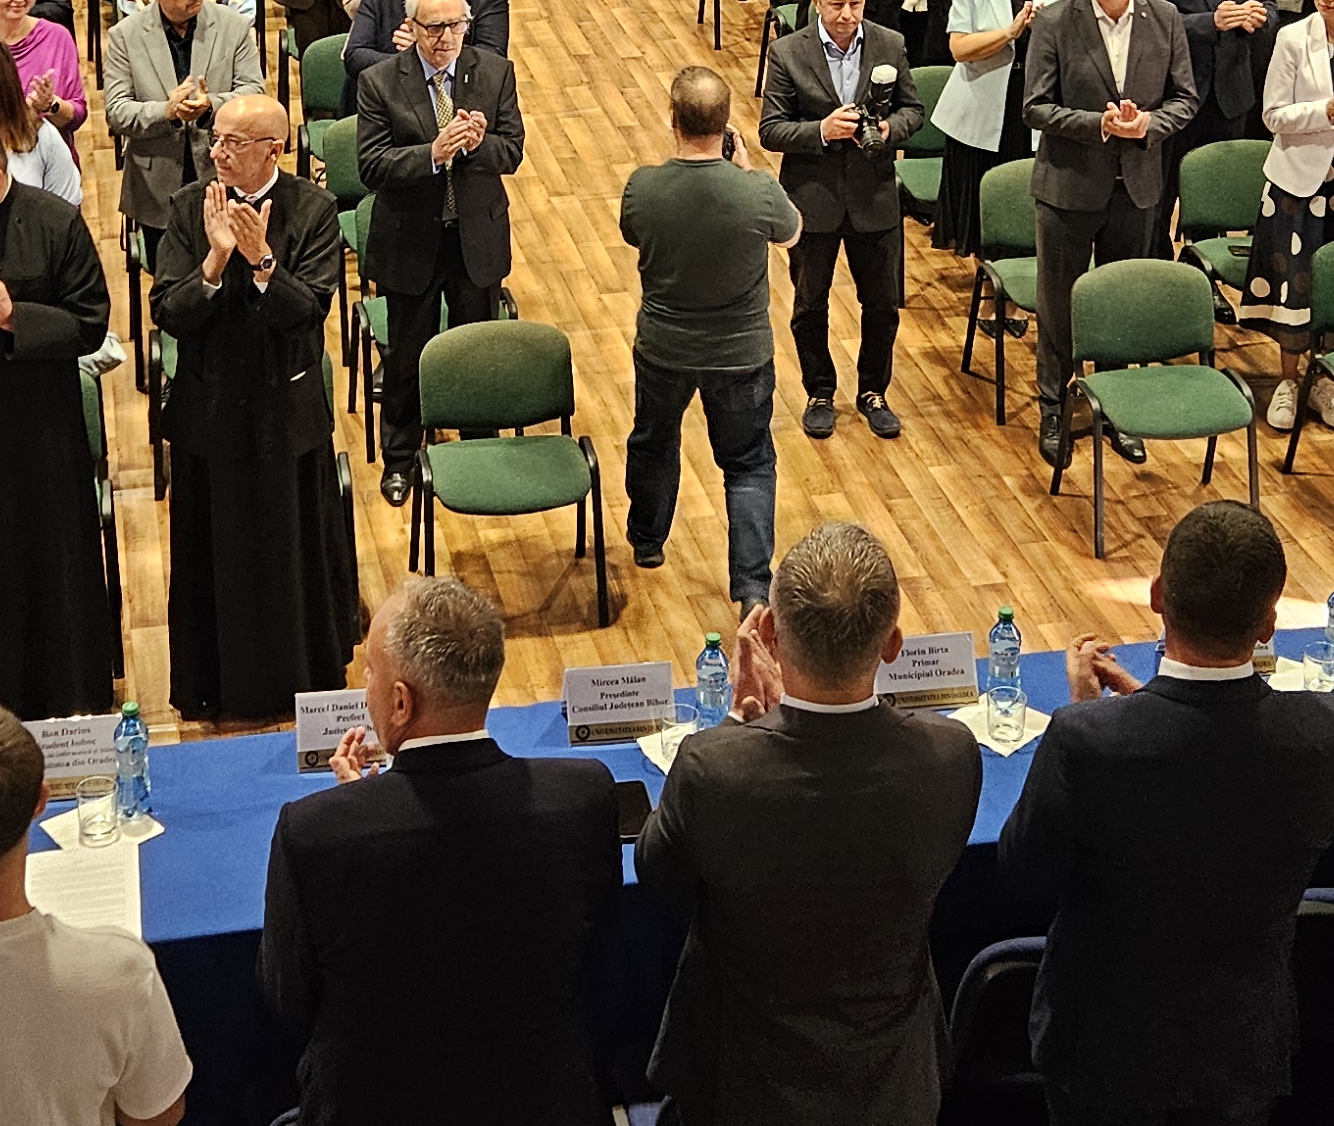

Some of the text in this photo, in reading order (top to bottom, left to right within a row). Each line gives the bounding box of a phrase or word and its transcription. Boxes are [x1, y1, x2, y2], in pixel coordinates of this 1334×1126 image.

[901, 646, 949, 657] Florin Birta
[912, 659, 940, 667] Primar
[888, 668, 964, 681] Municipiul Oradea
[591, 679, 619, 687] Mircea
[300, 704, 329, 714] Marcel
[331, 701, 358, 712] Daniel
[572, 703, 607, 713] Consiliul
[647, 698, 669, 707] Bihor
